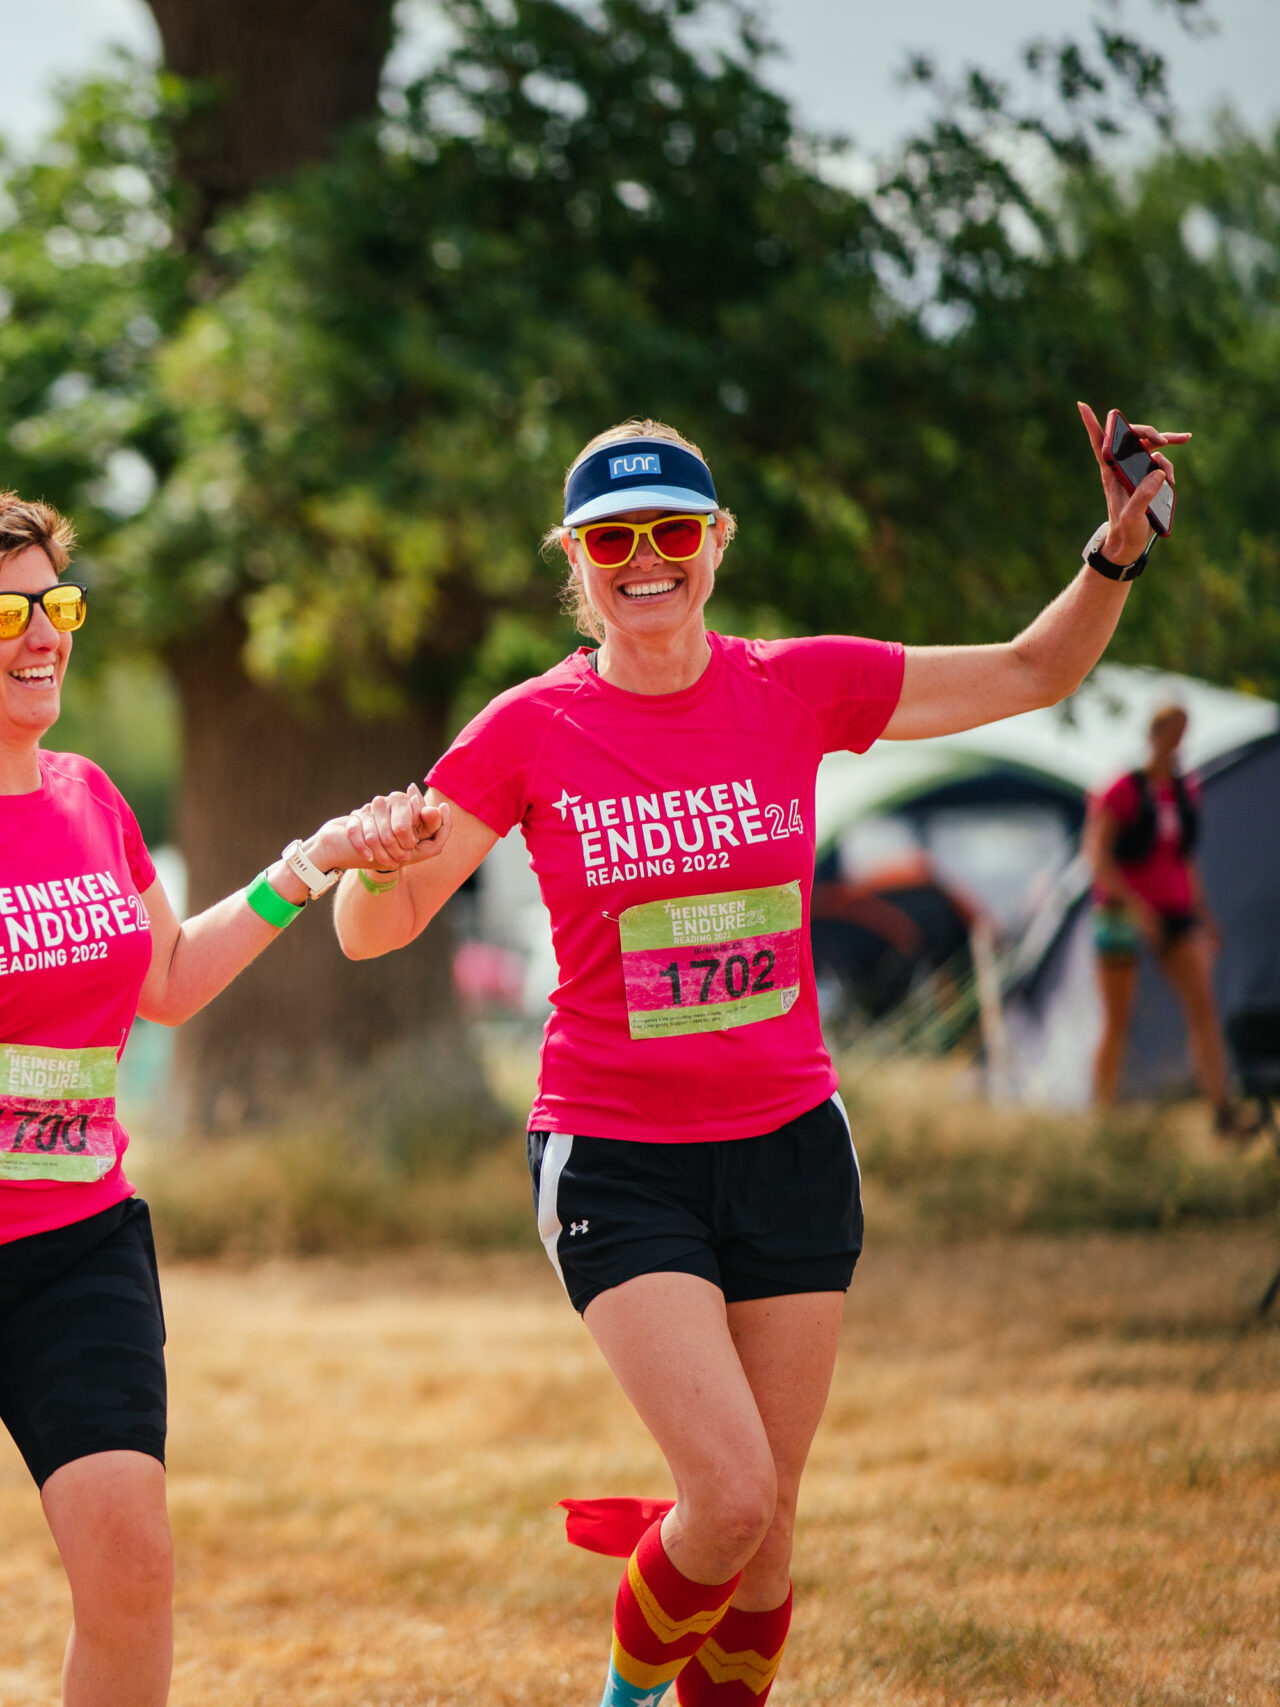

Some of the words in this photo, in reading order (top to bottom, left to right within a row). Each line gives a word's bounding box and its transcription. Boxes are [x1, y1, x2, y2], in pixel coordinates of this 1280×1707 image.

[571, 778, 758, 832] HEINEKEN
[580, 798, 804, 867] ENDURE24
[586, 859, 676, 887] READING
[681, 851, 730, 873] 2022
[671, 900, 746, 920] HEINEKEN
[671, 909, 766, 936] ENDURE24
[71, 941, 108, 964] 2022
[673, 935, 712, 945] READING
[659, 949, 775, 1005] 1702
[10, 1054, 81, 1073] HEINEKEN
